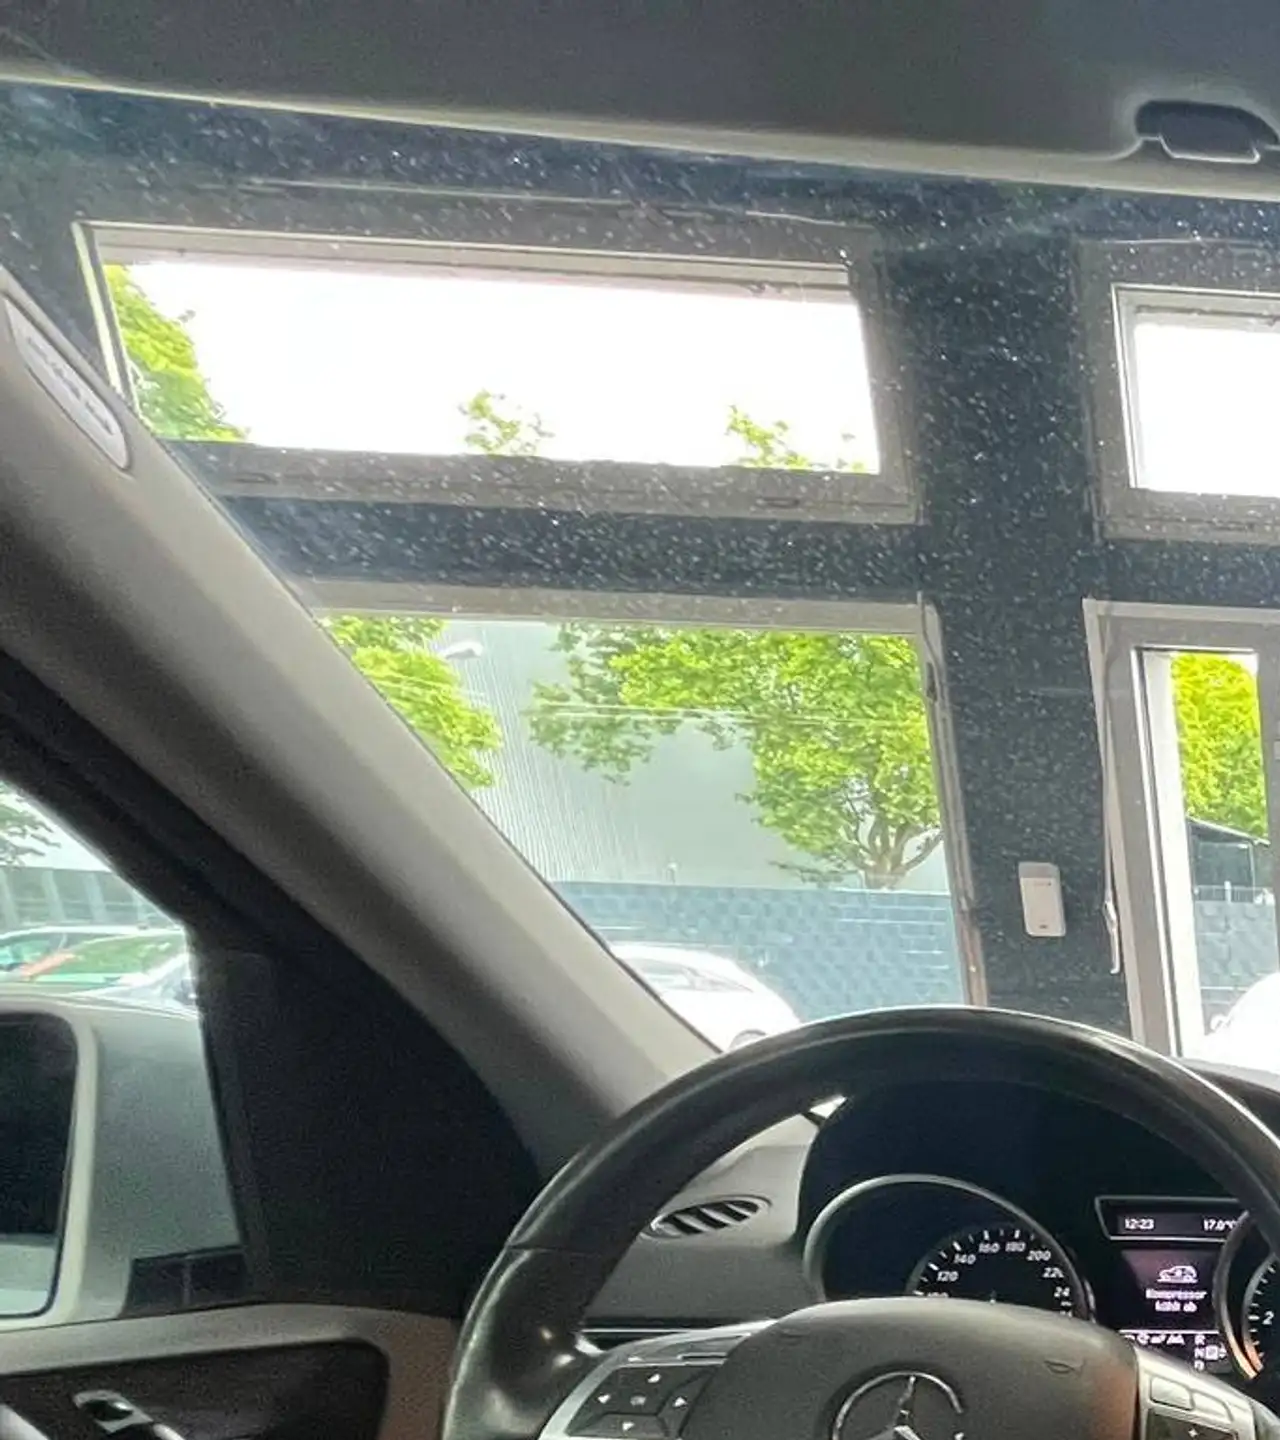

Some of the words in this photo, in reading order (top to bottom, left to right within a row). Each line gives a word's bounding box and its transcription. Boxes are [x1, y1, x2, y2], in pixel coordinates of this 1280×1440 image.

[1125, 1219, 1155, 1230] 12:23
[978, 1242, 1000, 1253] 160
[1005, 1241, 1026, 1252] 180
[953, 1254, 977, 1265] 140
[1026, 1250, 1051, 1262] 200
[936, 1271, 959, 1282] 120
[1261, 1311, 1275, 1325] 2
